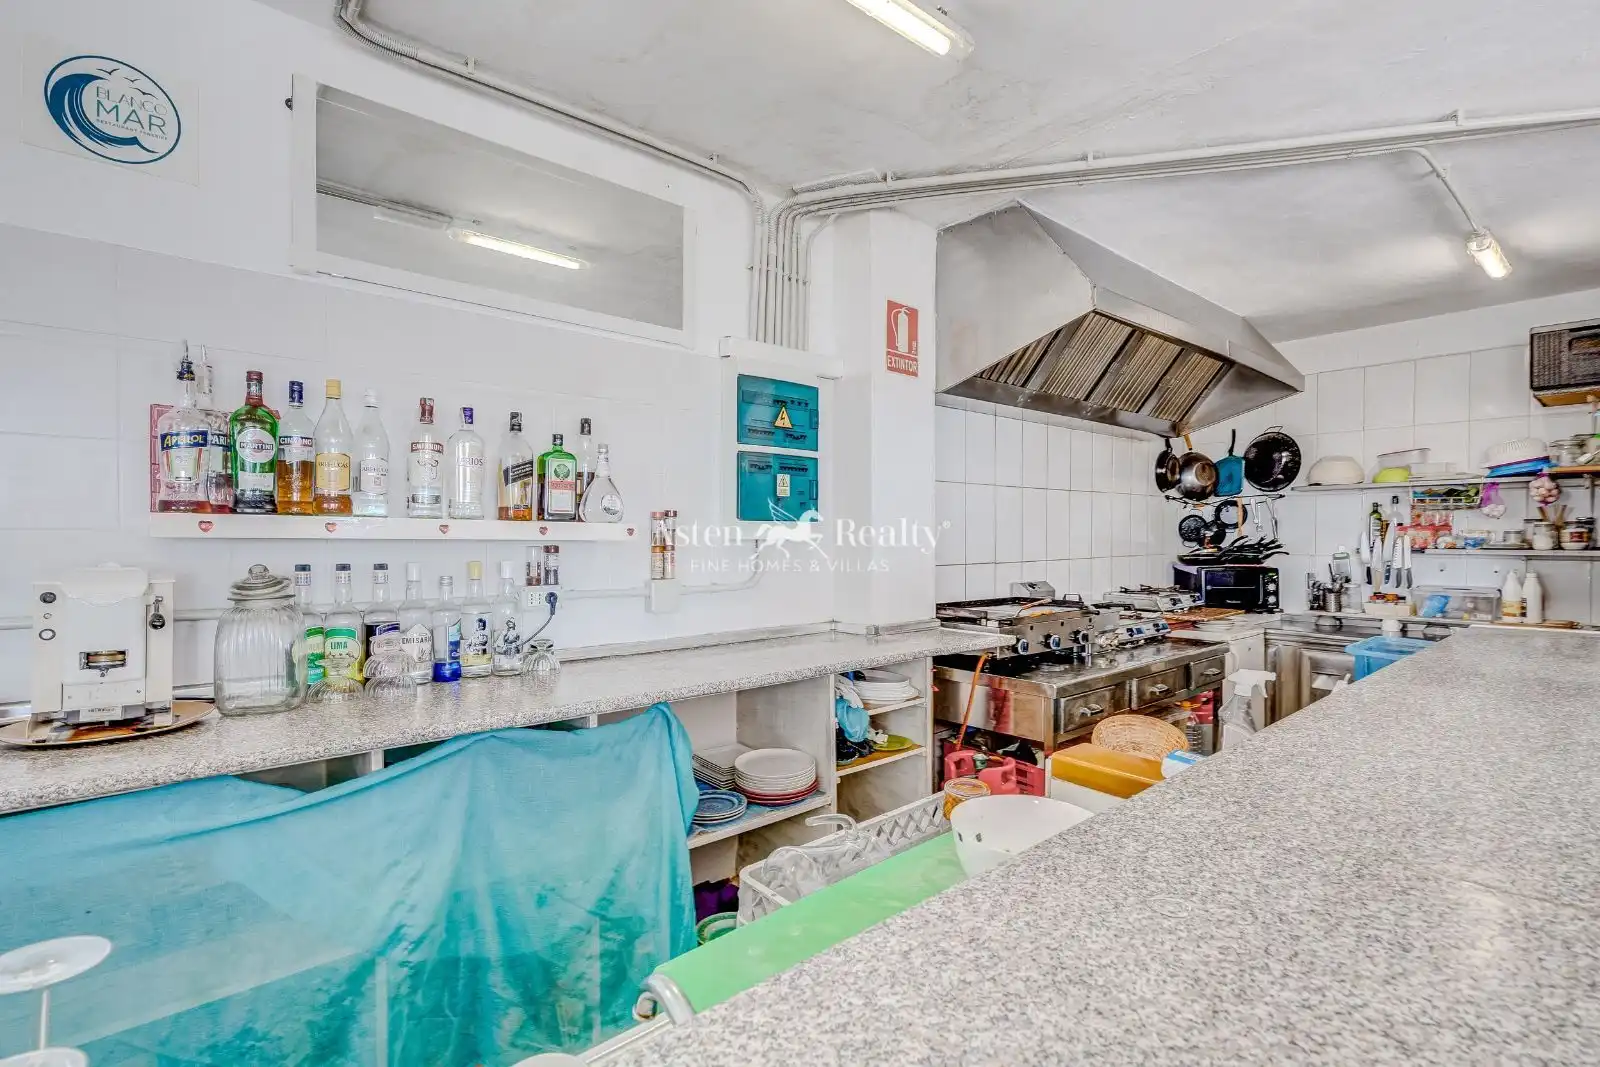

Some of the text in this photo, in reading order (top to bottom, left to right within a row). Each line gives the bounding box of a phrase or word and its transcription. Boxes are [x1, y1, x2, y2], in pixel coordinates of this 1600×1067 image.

[96, 86, 167, 116] BLANCO
[96, 99, 167, 136] MAR
[888, 355, 918, 372] EXTINTOR
[240, 442, 274, 451] MARTINI
[330, 641, 348, 650] LIMA
